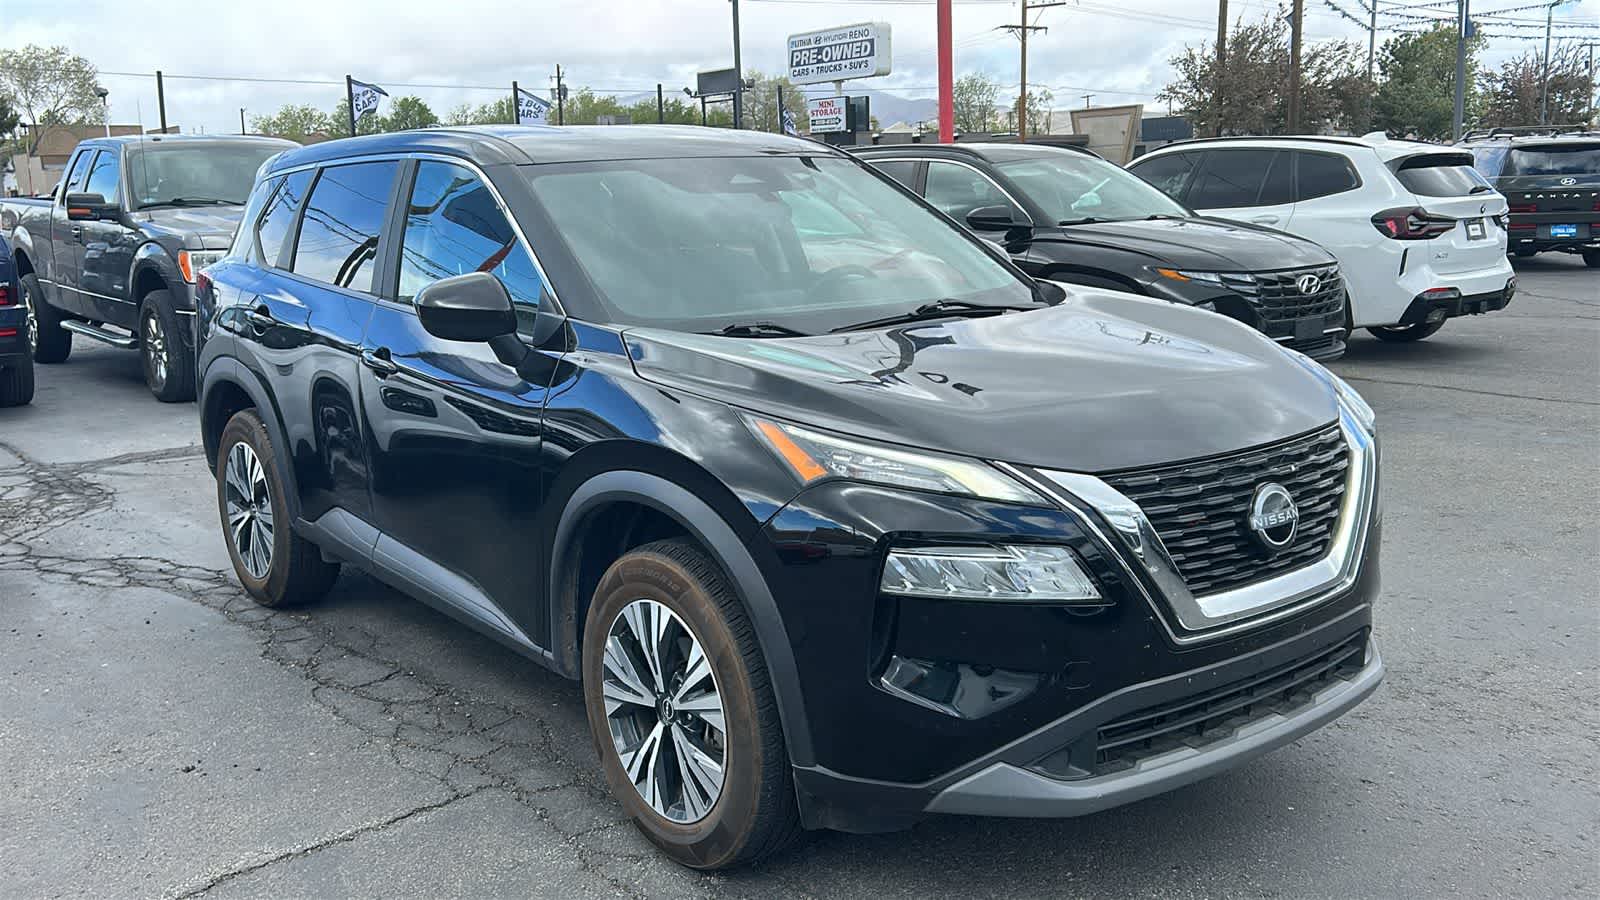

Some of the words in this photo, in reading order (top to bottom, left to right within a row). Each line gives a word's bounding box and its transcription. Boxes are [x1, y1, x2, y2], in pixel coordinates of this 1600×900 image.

[849, 28, 870, 39] RENO
[792, 41, 871, 66] PRE-OWNED
[792, 67, 810, 77] CARS
[816, 63, 842, 75] TRUCKS
[818, 100, 834, 108] MINI
[519, 109, 539, 119] ARS
[811, 107, 842, 117] STORAGE
[1253, 508, 1299, 528] NISSAN
